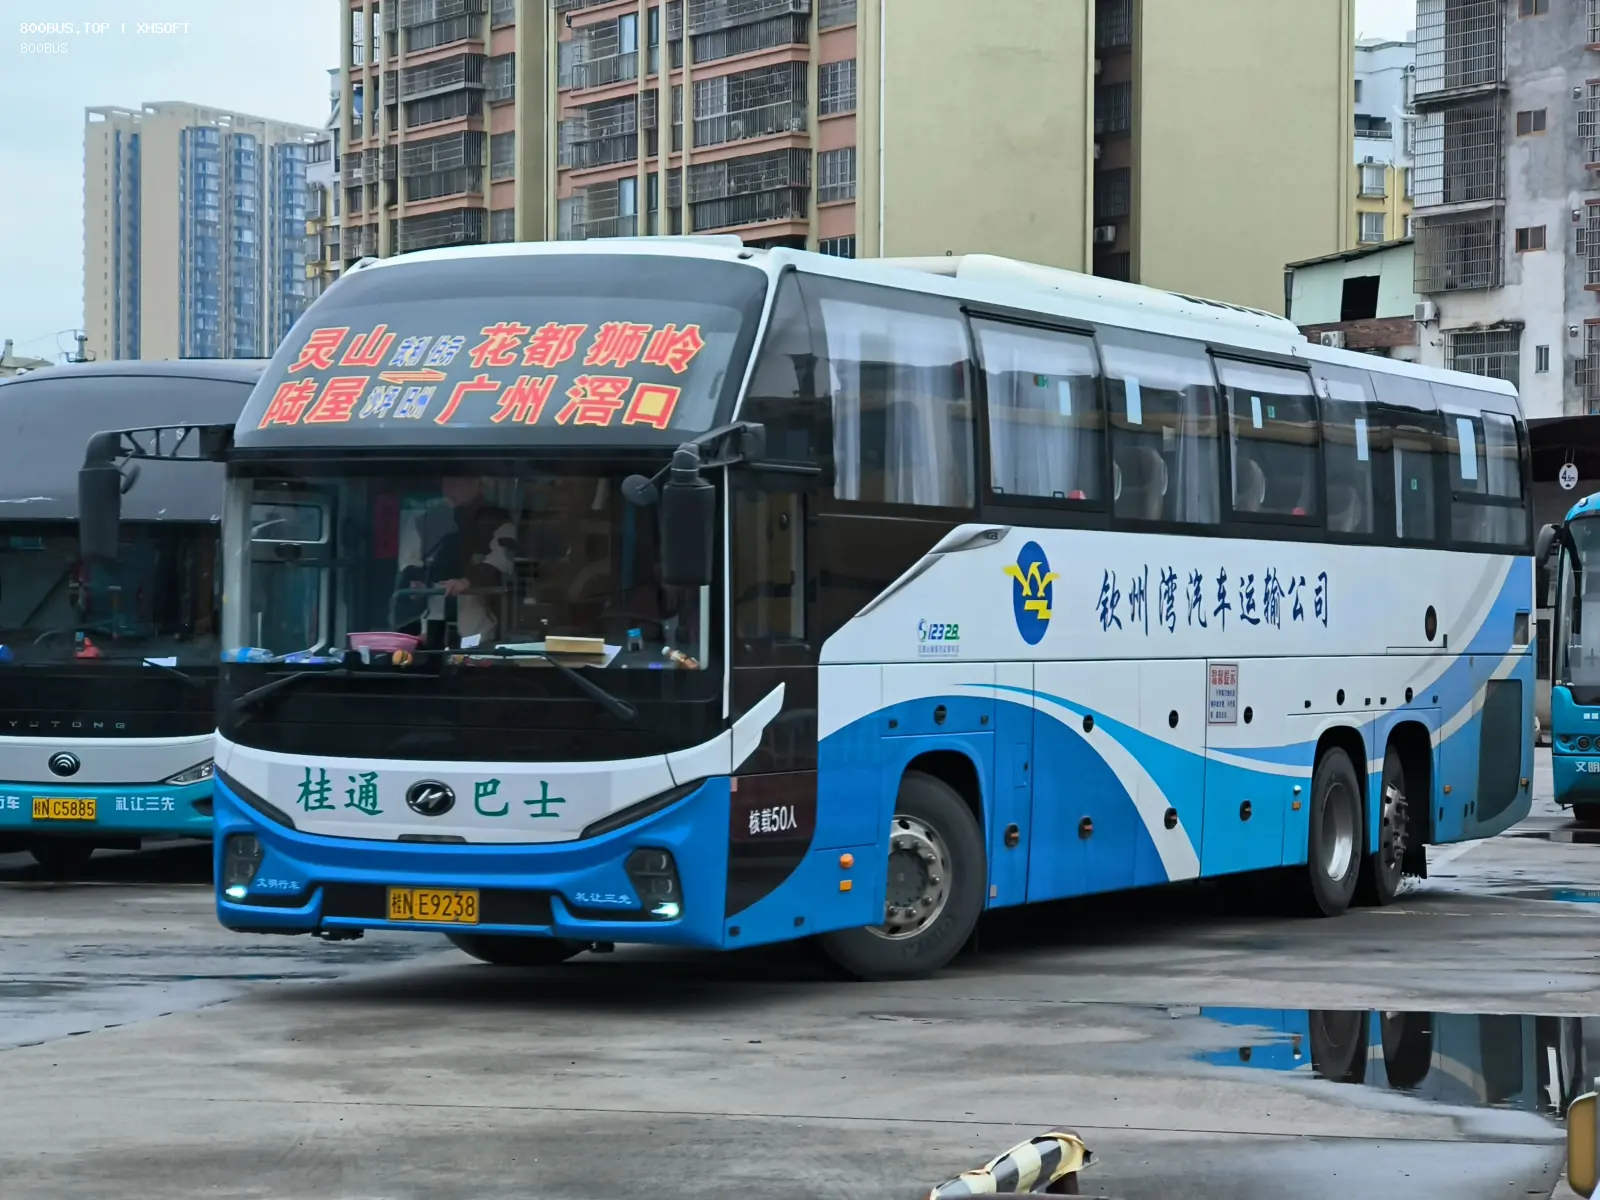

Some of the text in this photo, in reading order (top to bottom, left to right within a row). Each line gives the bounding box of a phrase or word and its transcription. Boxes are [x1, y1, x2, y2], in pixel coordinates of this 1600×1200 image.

[288, 323, 398, 374] 灵山
[468, 321, 588, 368] 花都
[582, 321, 706, 374] 狮岭
[258, 375, 370, 429] 陆屋
[433, 373, 559, 425] 广州
[554, 373, 682, 430] 滘口
[1096, 563, 1328, 636] 钦州湾汽车运输公司
[9, 721, 125, 729] YUTONG
[115, 796, 175, 811] 礼让三先
[297, 766, 566, 818] 桂通 巴士
[748, 805, 798, 835] 核载50人
[256, 877, 300, 890] 文明行车
